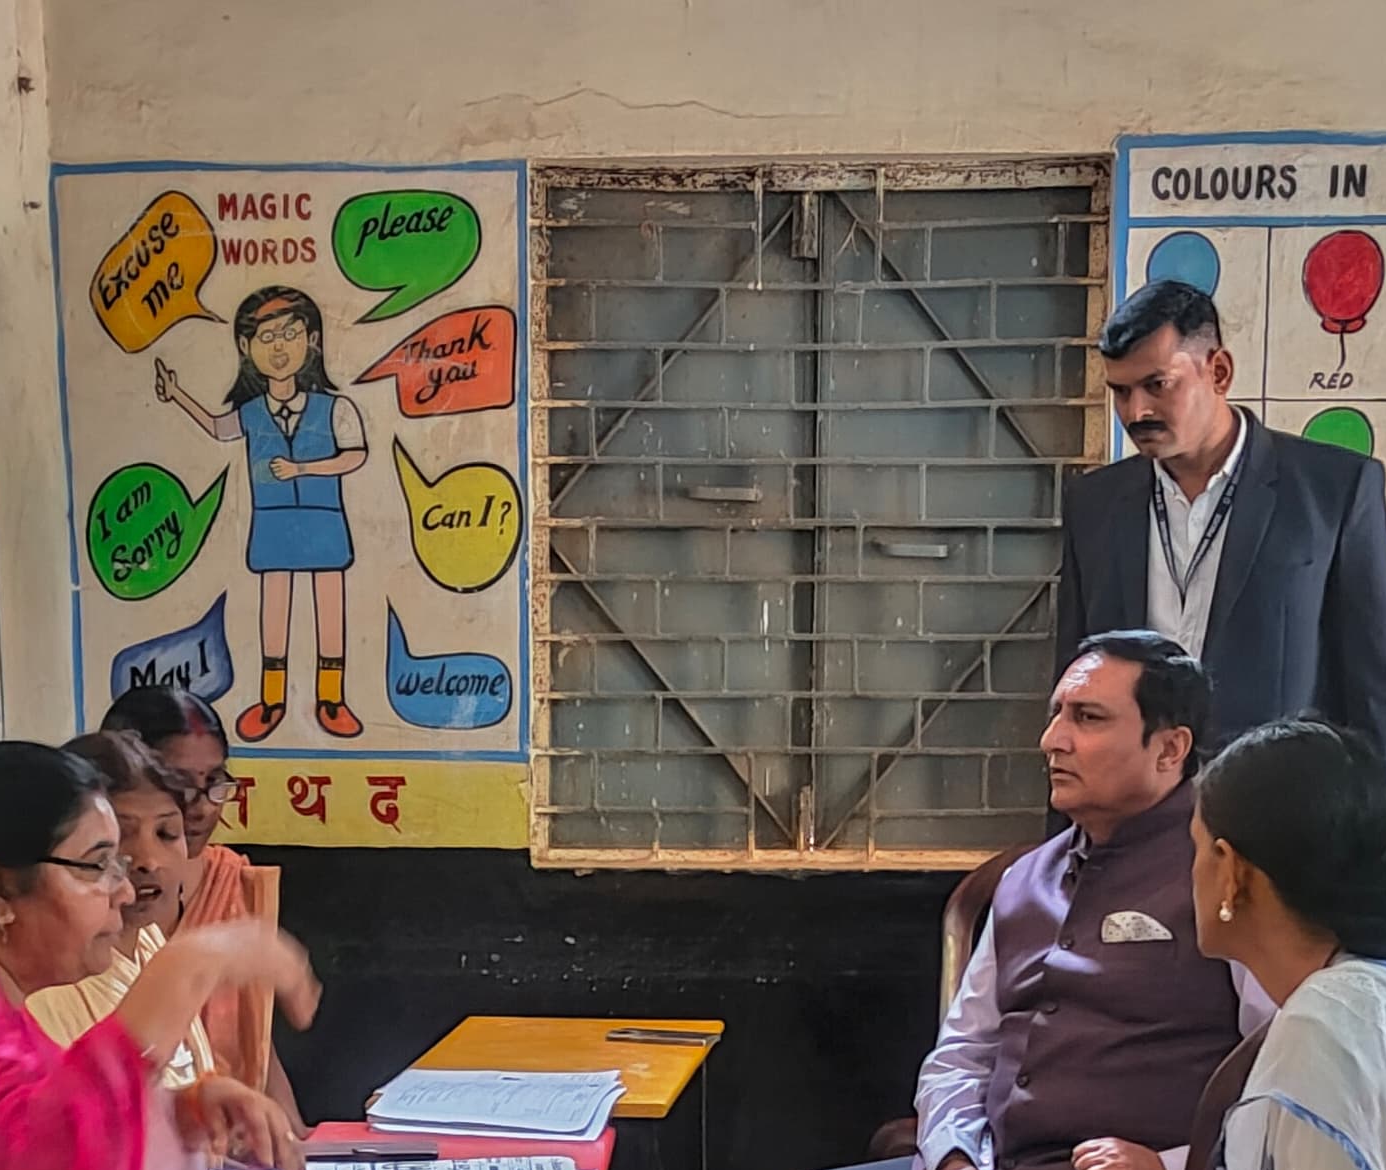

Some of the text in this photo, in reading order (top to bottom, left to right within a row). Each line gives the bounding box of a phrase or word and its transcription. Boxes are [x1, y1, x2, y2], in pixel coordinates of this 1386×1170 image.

[218, 193, 312, 221] MAGIC
[1151, 164, 1297, 200] COLOURS
[1329, 164, 1367, 198] IN
[98, 212, 180, 310] Excuse
[221, 237, 317, 265] WORDS
[141, 261, 185, 319] me
[402, 314, 492, 363] Thank
[1309, 371, 1353, 389] RED
[97, 481, 151, 541] I am
[421, 503, 472, 530] Can
[111, 510, 184, 582] Sorry
[130, 638, 211, 692] May I
[287, 775, 332, 824] थ
[365, 776, 407, 834] द
